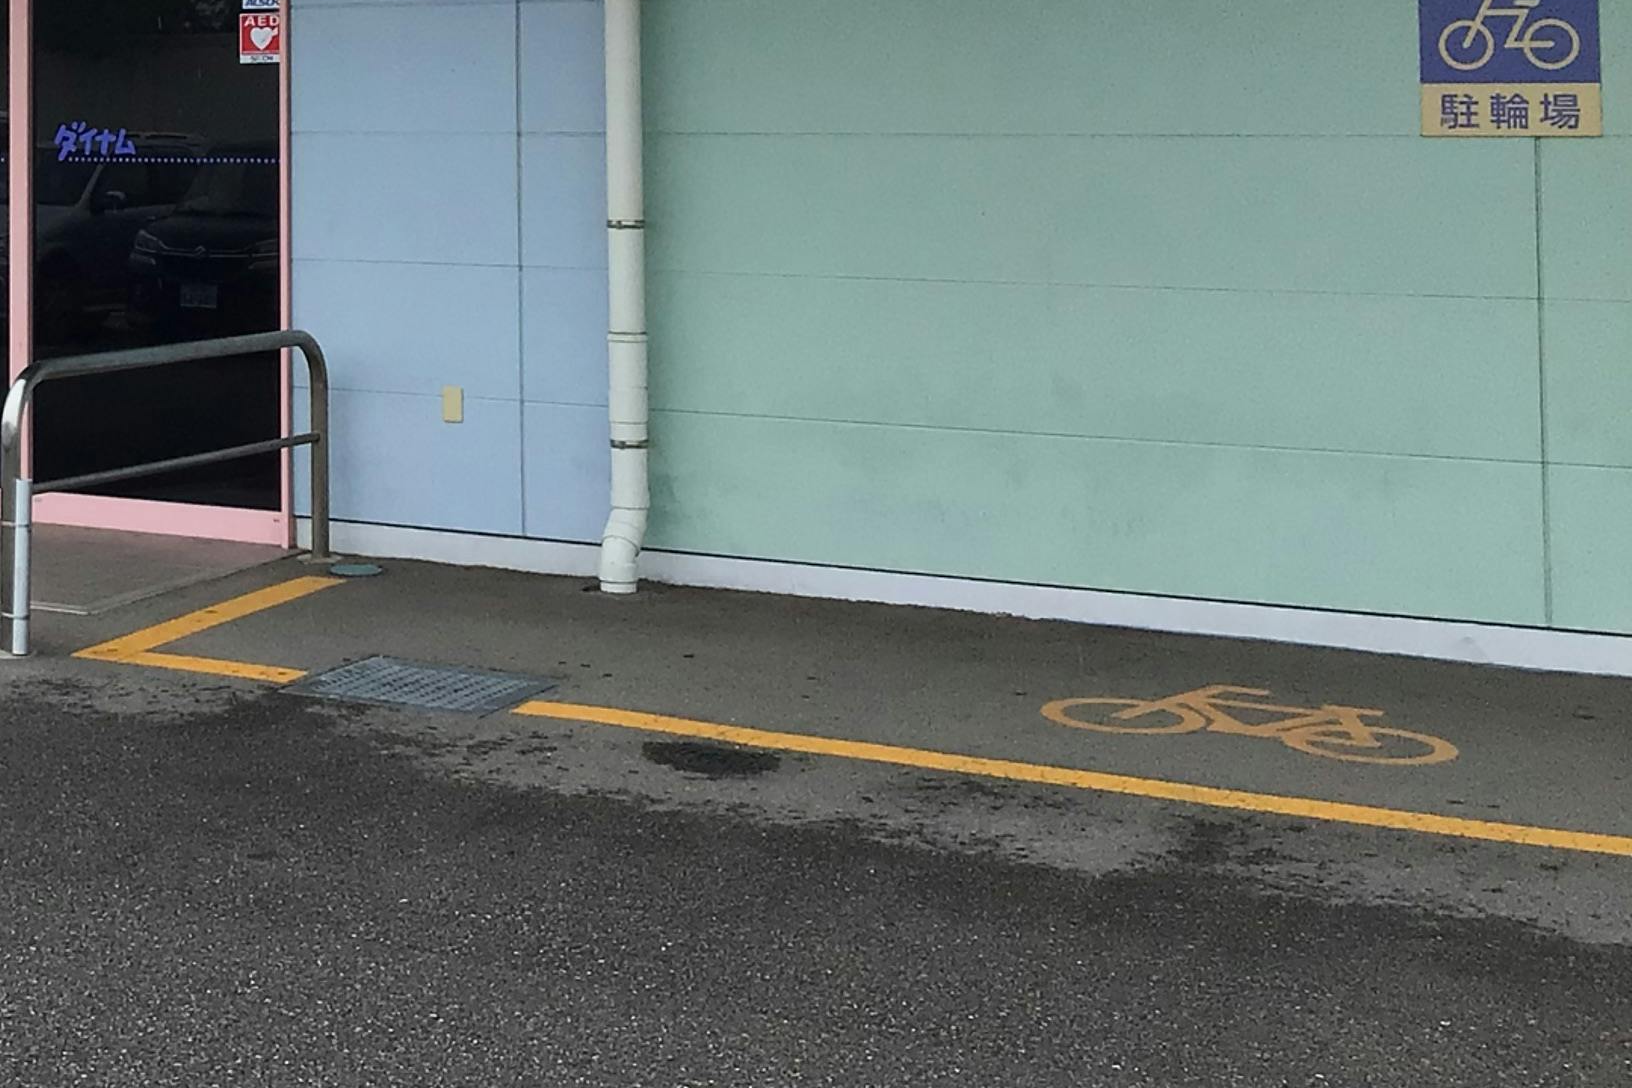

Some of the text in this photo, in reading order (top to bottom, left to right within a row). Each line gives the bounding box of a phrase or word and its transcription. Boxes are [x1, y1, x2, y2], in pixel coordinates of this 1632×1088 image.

[243, 15, 280, 27] AED
[1440, 92, 1581, 130] 駐輪場
[54, 121, 136, 161] ダイナム
